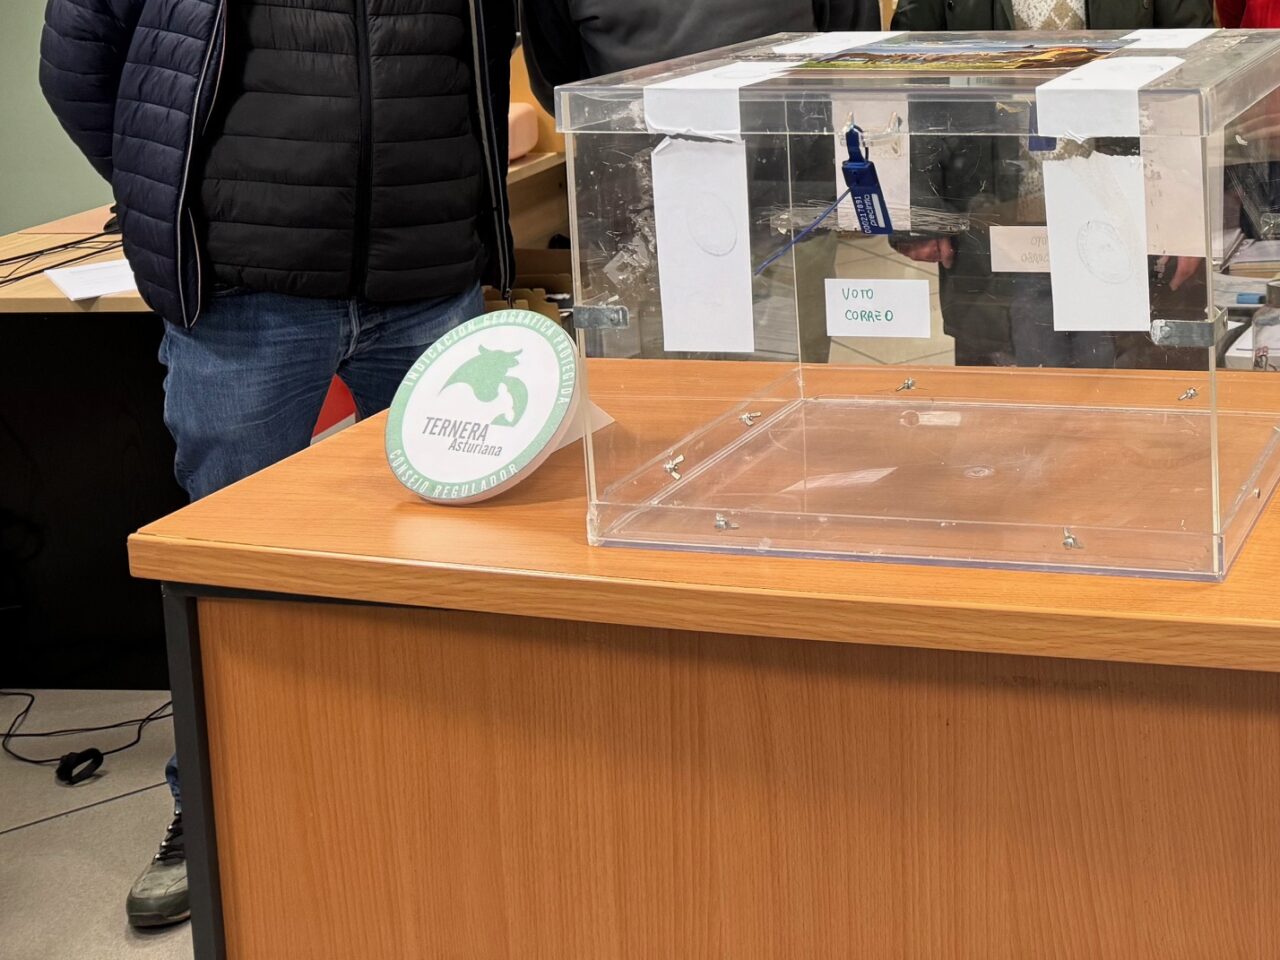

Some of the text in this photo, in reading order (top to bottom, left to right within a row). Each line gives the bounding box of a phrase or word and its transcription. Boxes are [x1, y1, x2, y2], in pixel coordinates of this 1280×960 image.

[842, 287, 874, 300] VOTO
[403, 309, 576, 405] INDICACION GEOGRAFICA PROTEGIDA
[422, 416, 490, 443] TERNERA
[448, 437, 503, 457] Asturiana
[388, 448, 519, 499] CONSEJO REGULADOR
